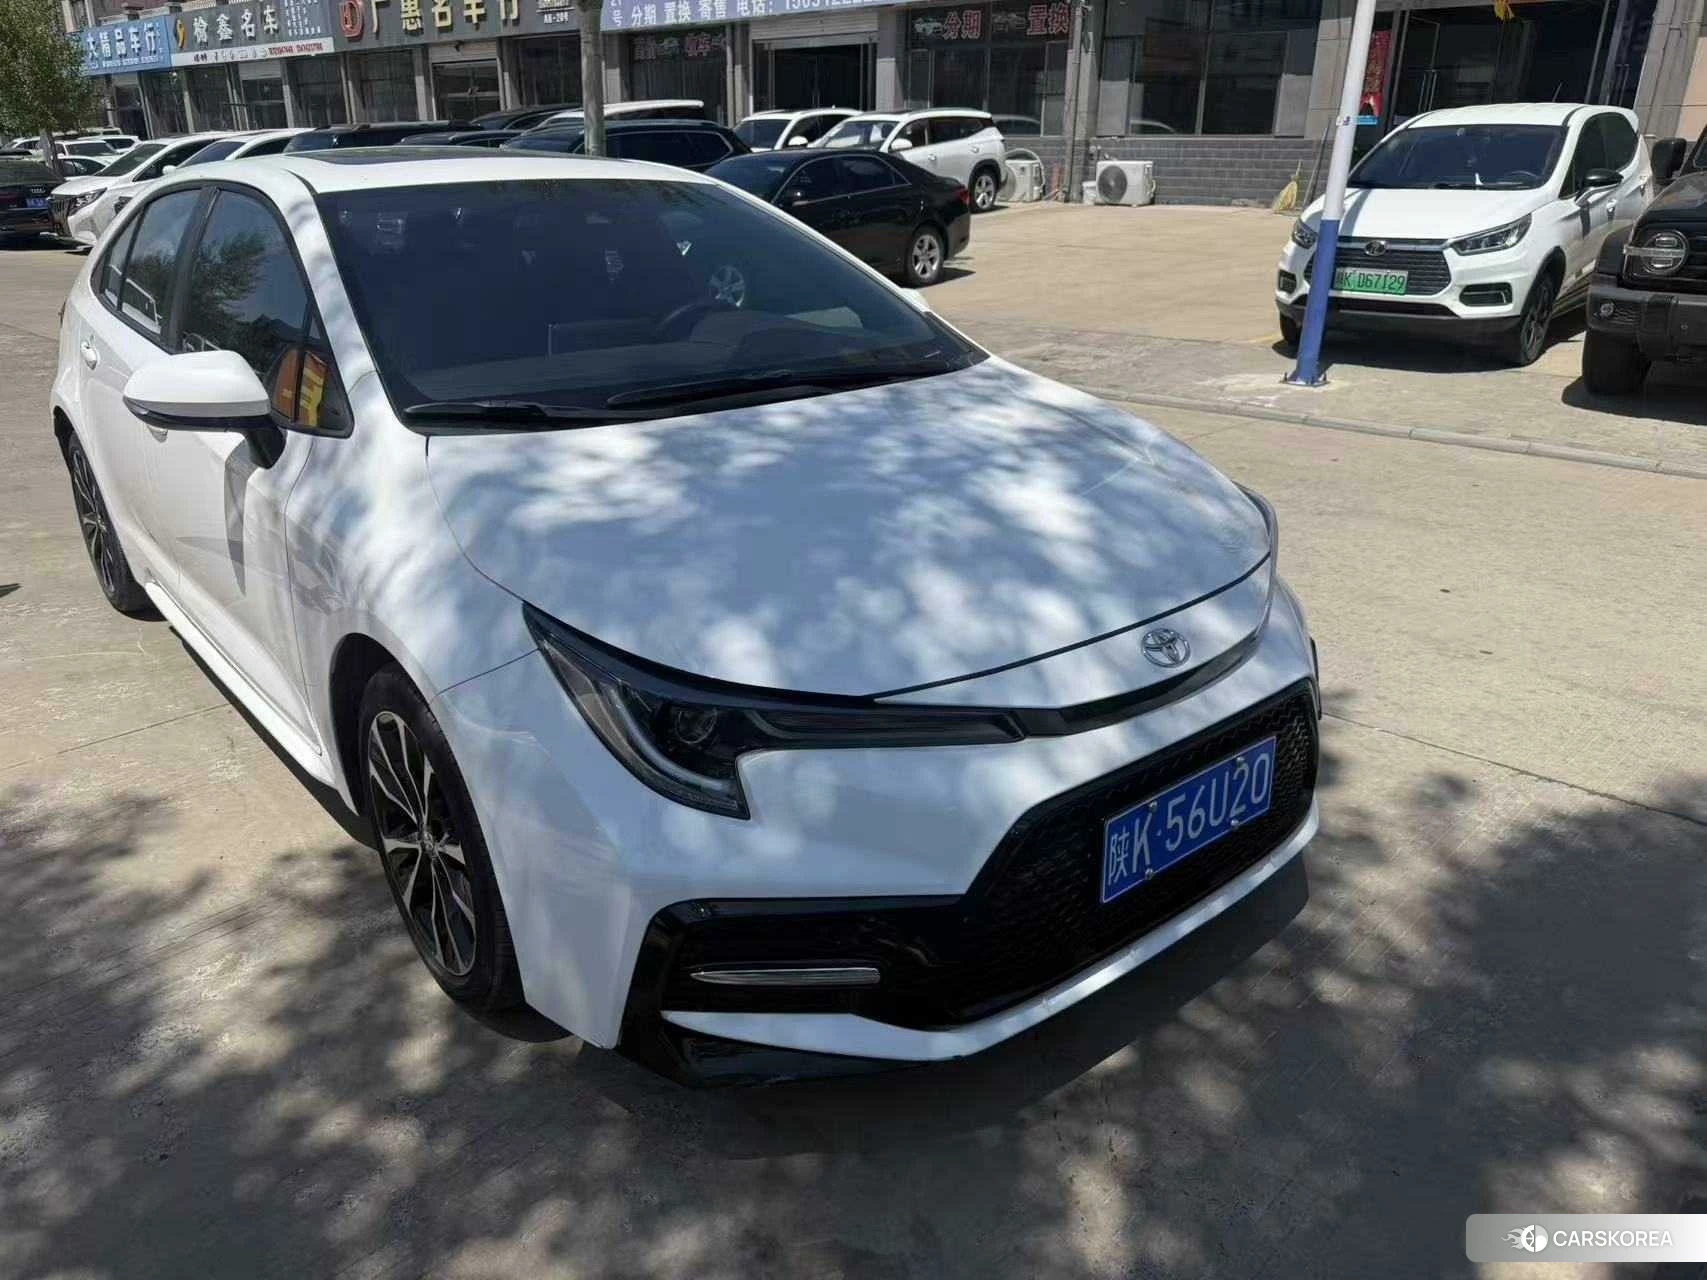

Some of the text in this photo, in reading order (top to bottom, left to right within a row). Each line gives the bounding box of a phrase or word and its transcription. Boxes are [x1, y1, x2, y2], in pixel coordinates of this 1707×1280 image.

[631, 3, 657, 26] 分期
[663, 1, 692, 25] 置换
[943, 9, 983, 41] 分期
[1026, 3, 1071, 36] 置换
